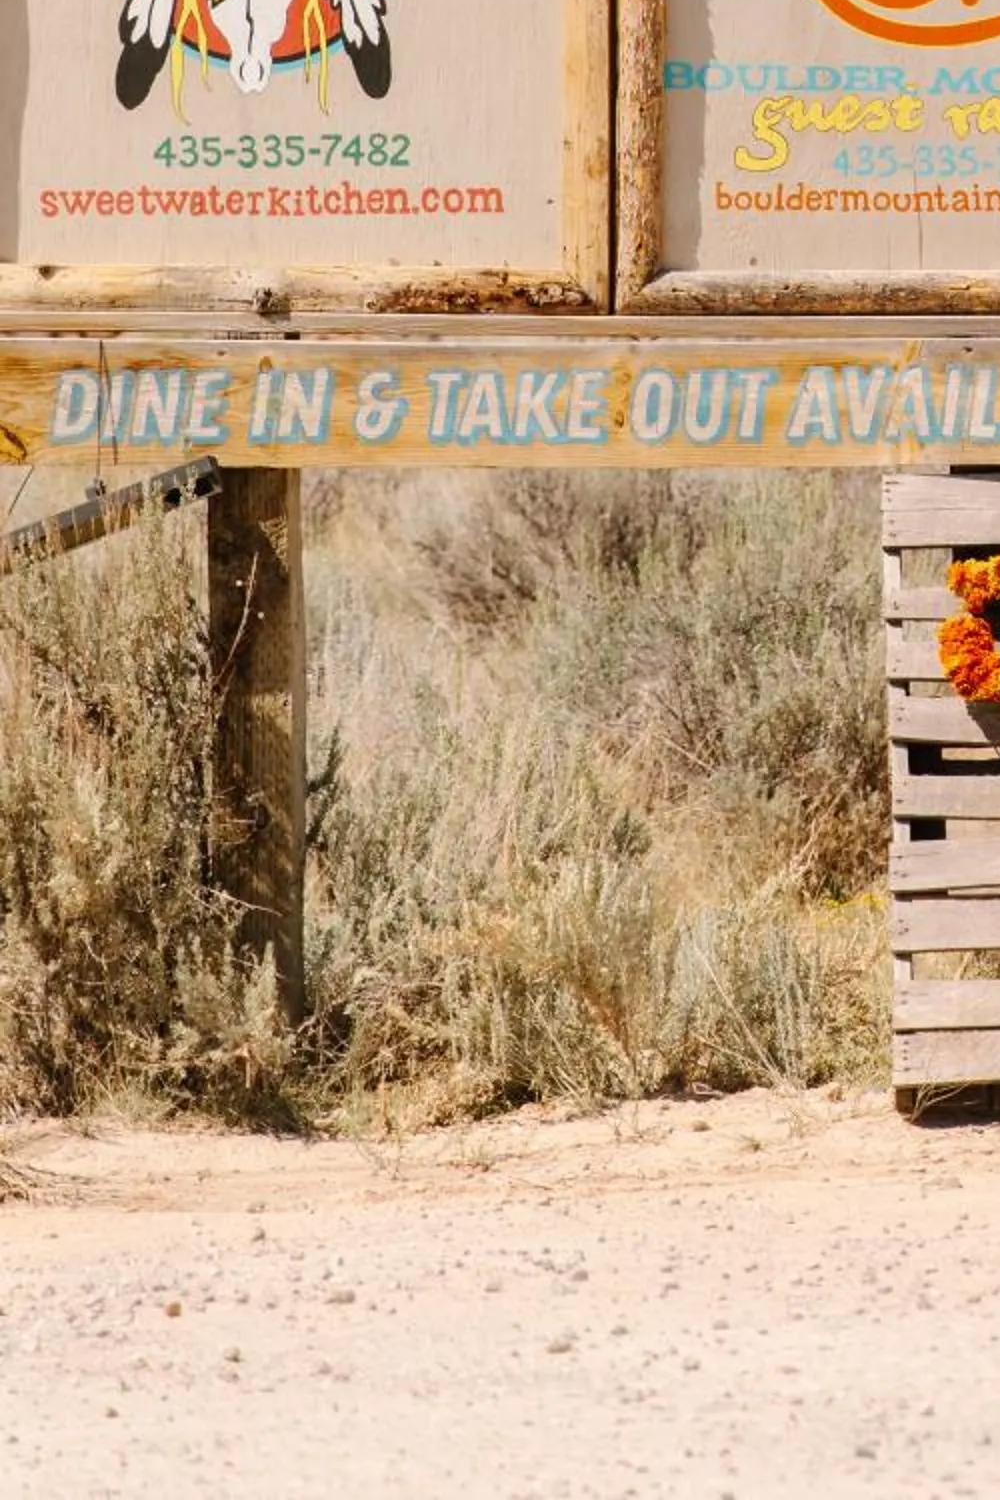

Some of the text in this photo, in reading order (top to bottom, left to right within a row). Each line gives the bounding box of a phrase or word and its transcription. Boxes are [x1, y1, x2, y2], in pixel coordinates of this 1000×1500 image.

[664, 59, 917, 94] BOULDER
[733, 88, 925, 172] guest
[153, 133, 412, 168] 435-335-7482
[39, 181, 505, 218] sweetwaterkitchen.com
[50, 368, 232, 446] DINE
[248, 367, 334, 445] IN
[354, 370, 409, 443] &
[427, 367, 611, 446] TAKE
[630, 366, 779, 445] OUT
